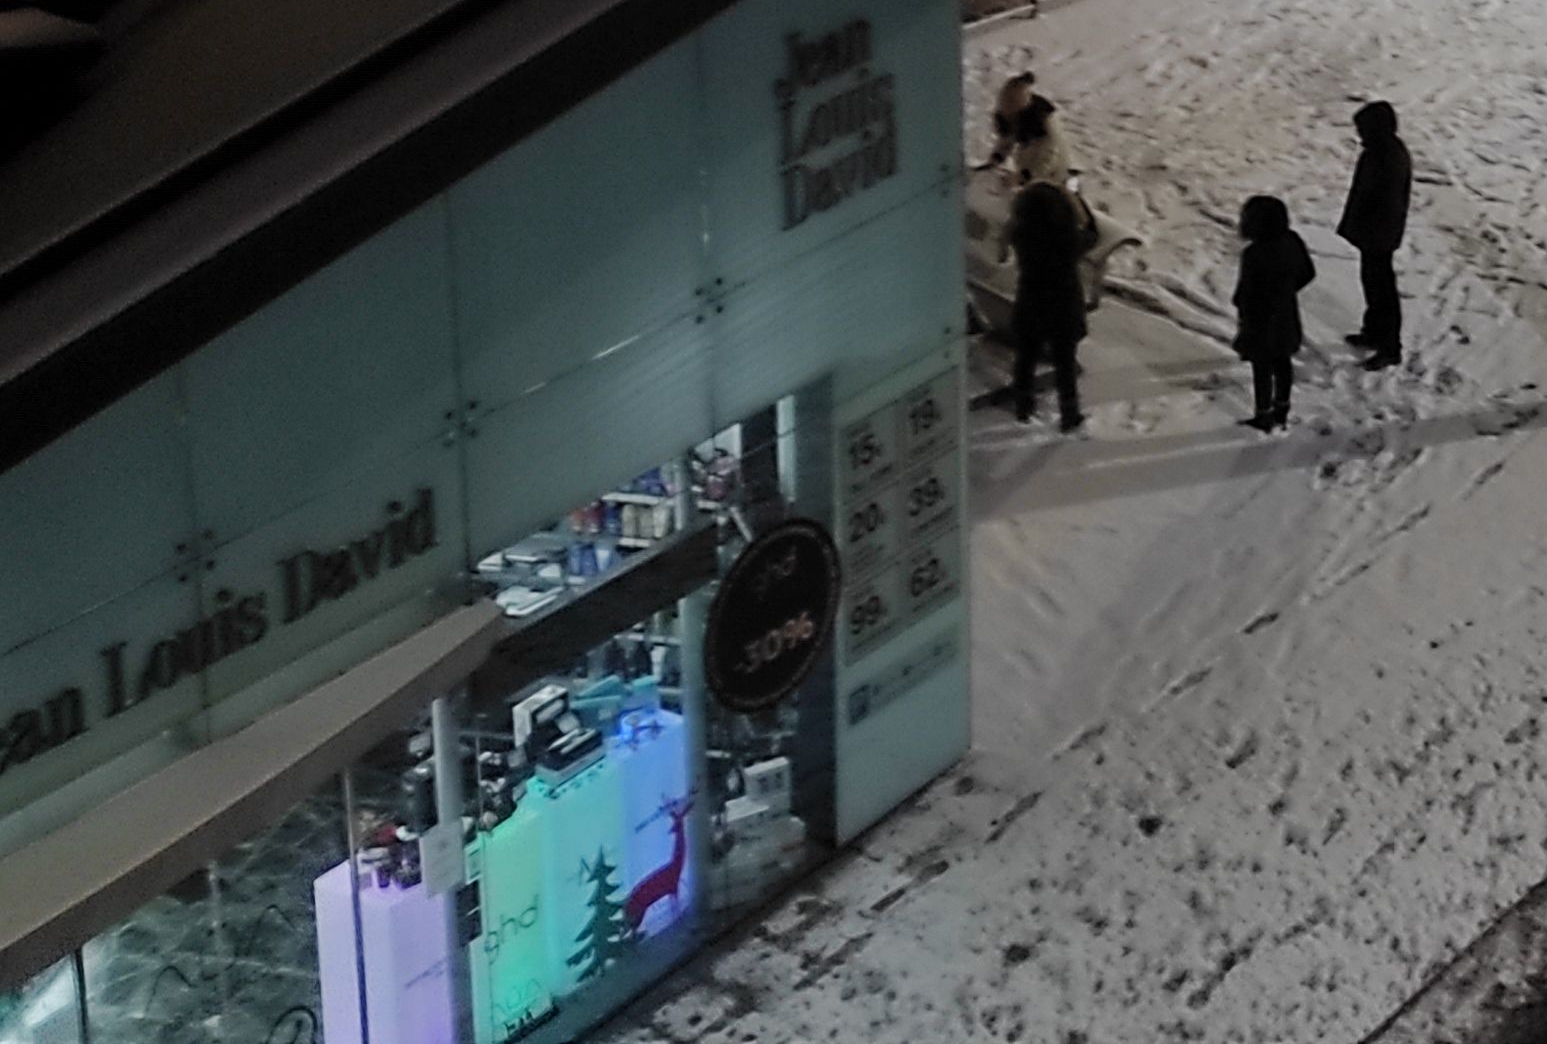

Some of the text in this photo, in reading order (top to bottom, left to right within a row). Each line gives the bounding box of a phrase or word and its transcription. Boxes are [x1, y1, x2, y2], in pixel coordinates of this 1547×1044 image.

[778, 68, 896, 174] Louis
[781, 130, 896, 231] David
[101, 589, 270, 717] Louis
[277, 488, 440, 624] David
